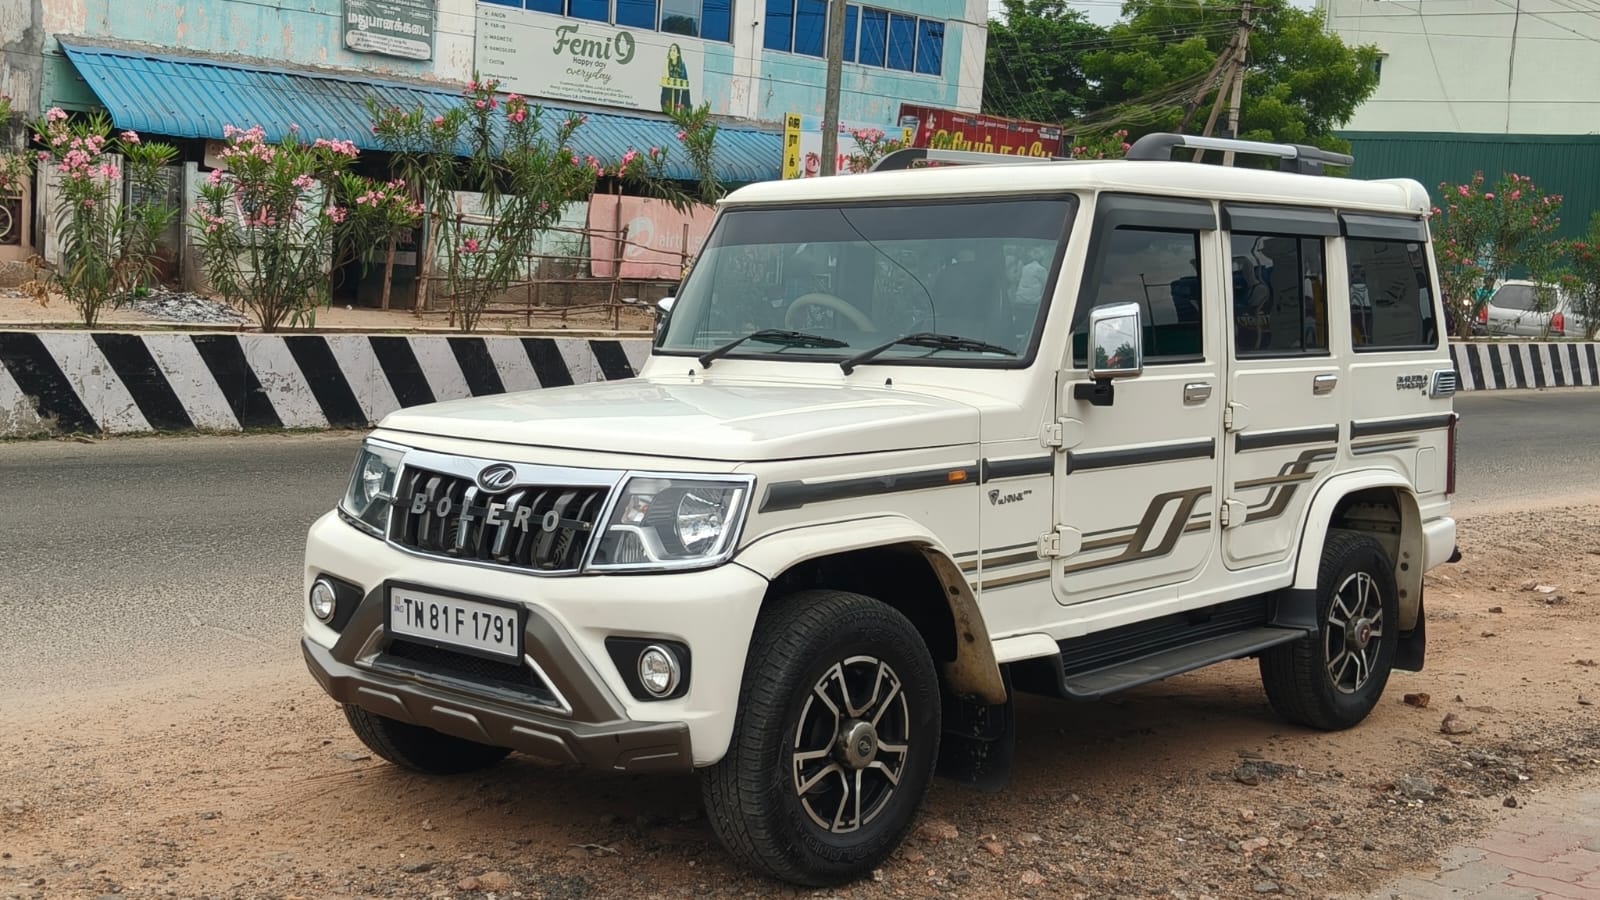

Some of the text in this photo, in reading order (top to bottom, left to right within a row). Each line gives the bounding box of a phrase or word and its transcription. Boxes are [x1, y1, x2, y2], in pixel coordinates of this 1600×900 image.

[566, 67, 612, 84] everyday
[572, 56, 607, 69] Happy day
[411, 493, 560, 533] BOLERO
[404, 598, 515, 647] TN 81 F 1791
